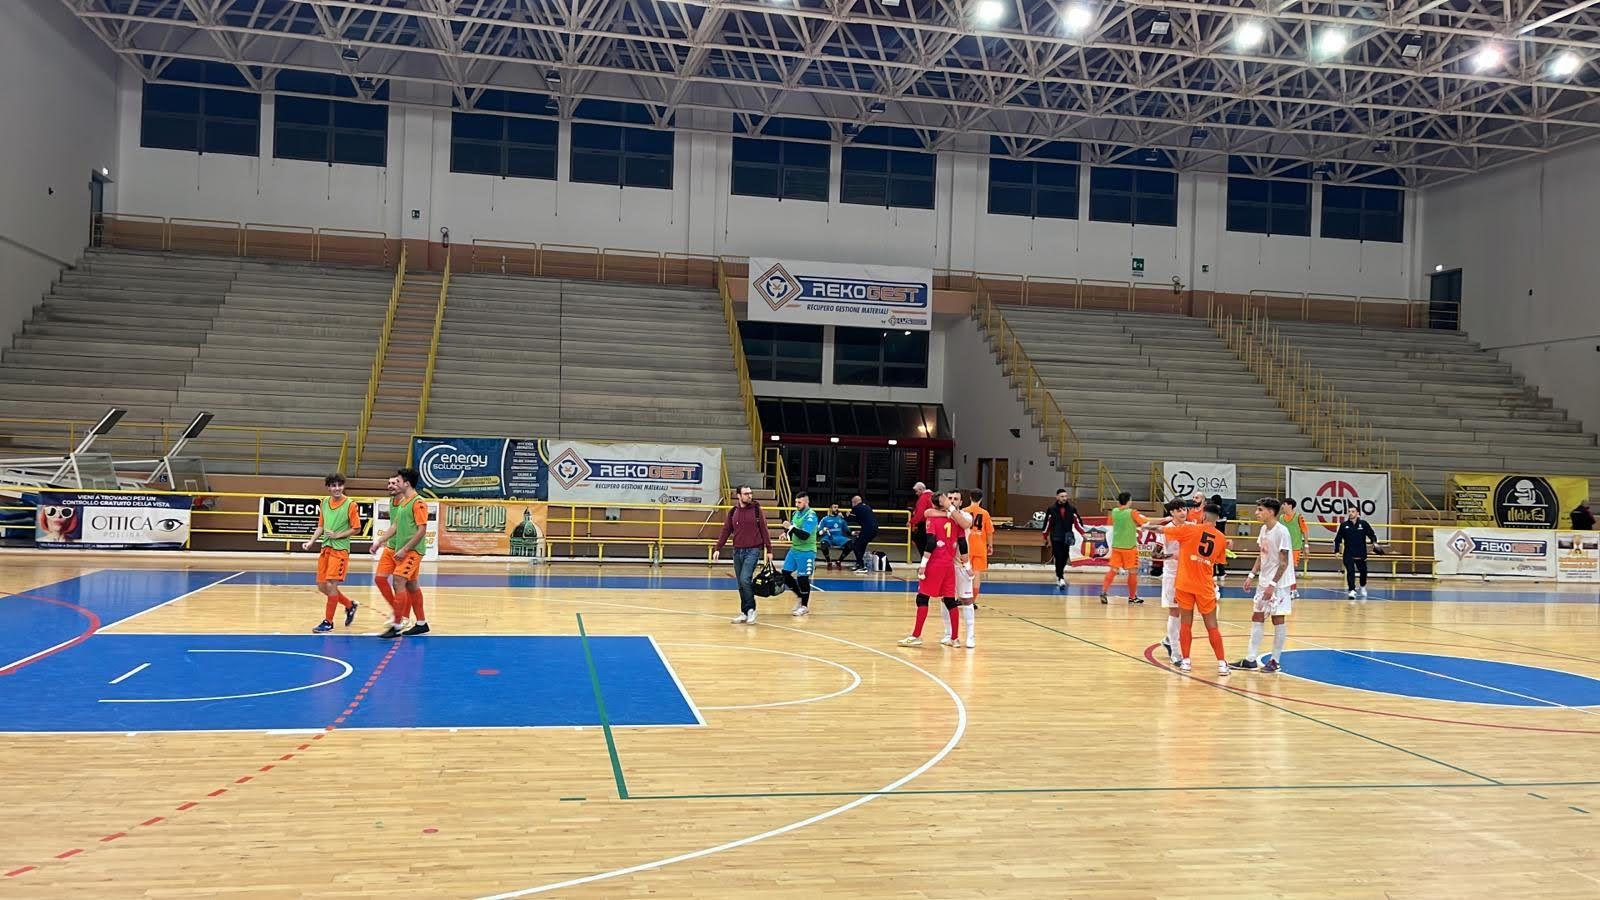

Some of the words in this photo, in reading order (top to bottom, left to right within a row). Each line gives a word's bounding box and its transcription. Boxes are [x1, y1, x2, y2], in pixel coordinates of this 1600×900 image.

[813, 283, 919, 303] REKOGEST
[806, 303, 834, 312] RECUPERO
[835, 305, 861, 314] GESTIONE
[861, 307, 889, 315] MATERIALI
[440, 453, 488, 467] energy
[600, 464, 696, 480] REKOGEST
[595, 482, 620, 490] RECUPERO
[621, 483, 643, 491] GESTIONE
[1301, 496, 1376, 516] CASCINO
[91, 515, 153, 531] OTTICA
[943, 522, 952, 538] 1
[1198, 531, 1216, 557] 5
